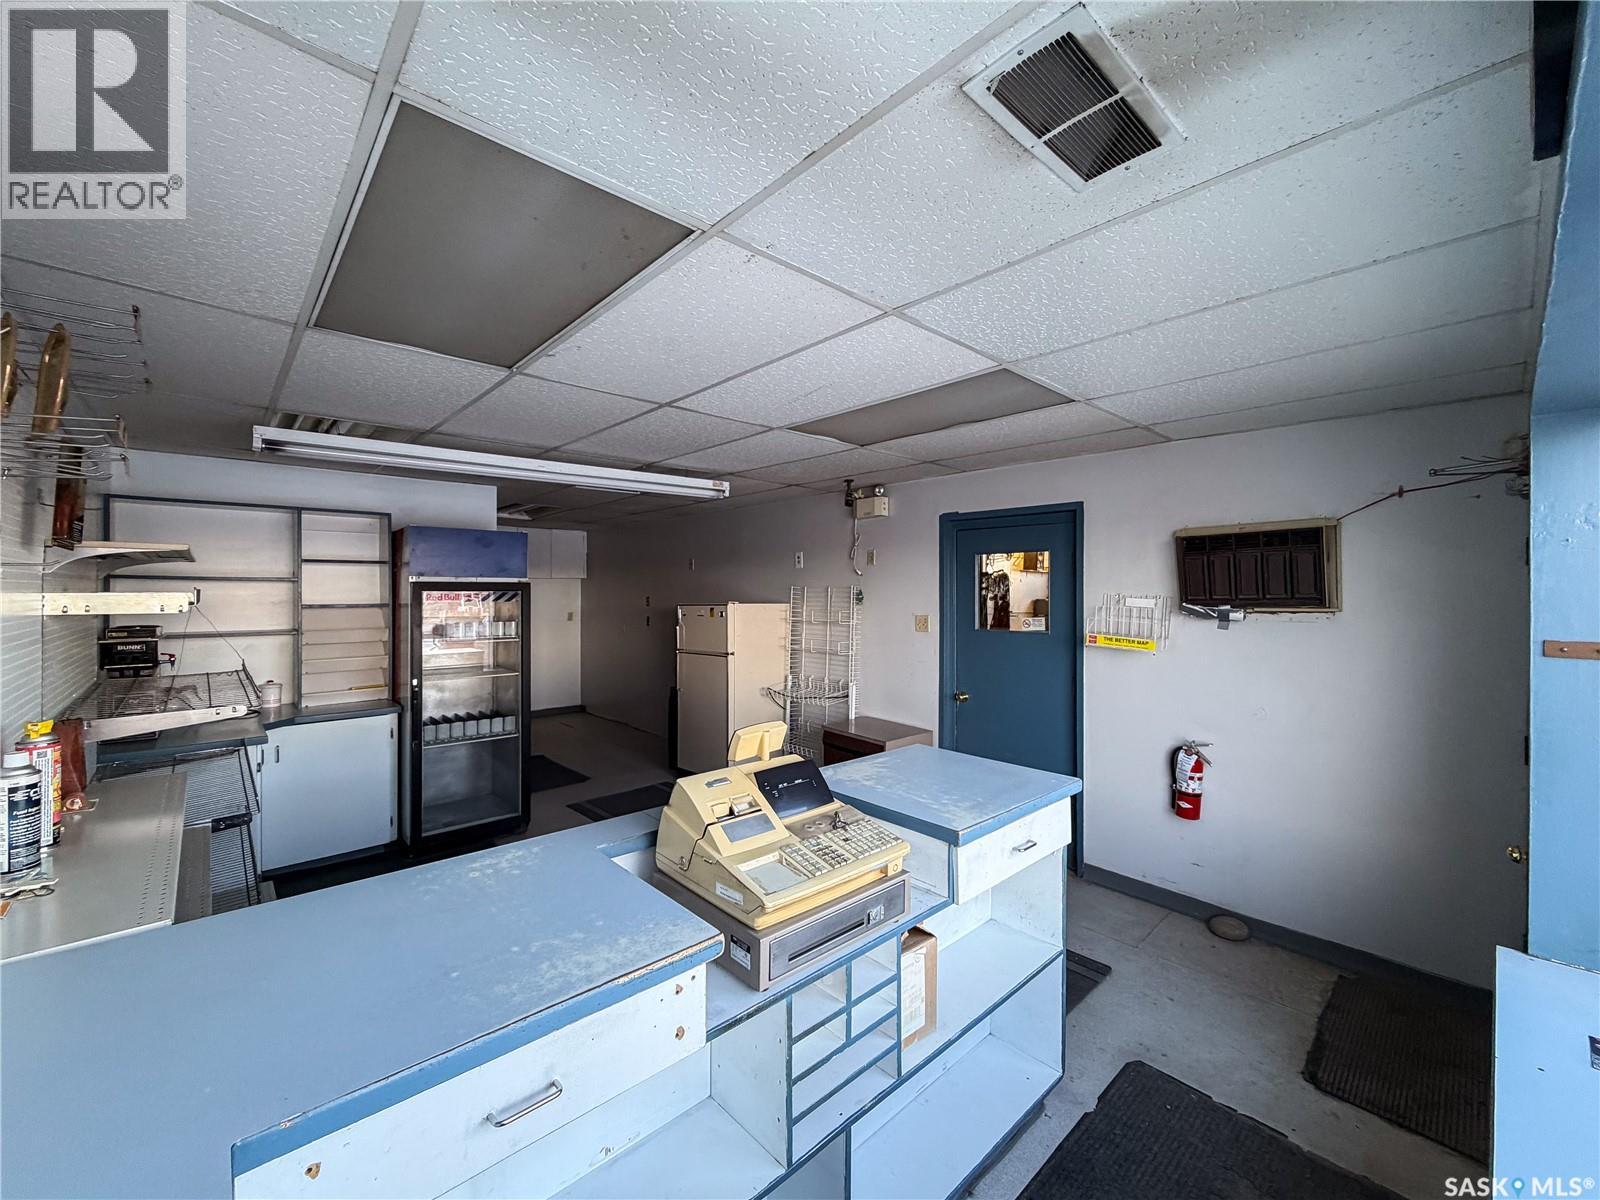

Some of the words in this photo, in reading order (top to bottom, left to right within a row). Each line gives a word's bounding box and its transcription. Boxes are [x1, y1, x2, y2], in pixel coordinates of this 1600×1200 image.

[425, 593, 443, 601] Red
[444, 593, 460, 601] Bull
[1114, 637, 1136, 645] BETTER
